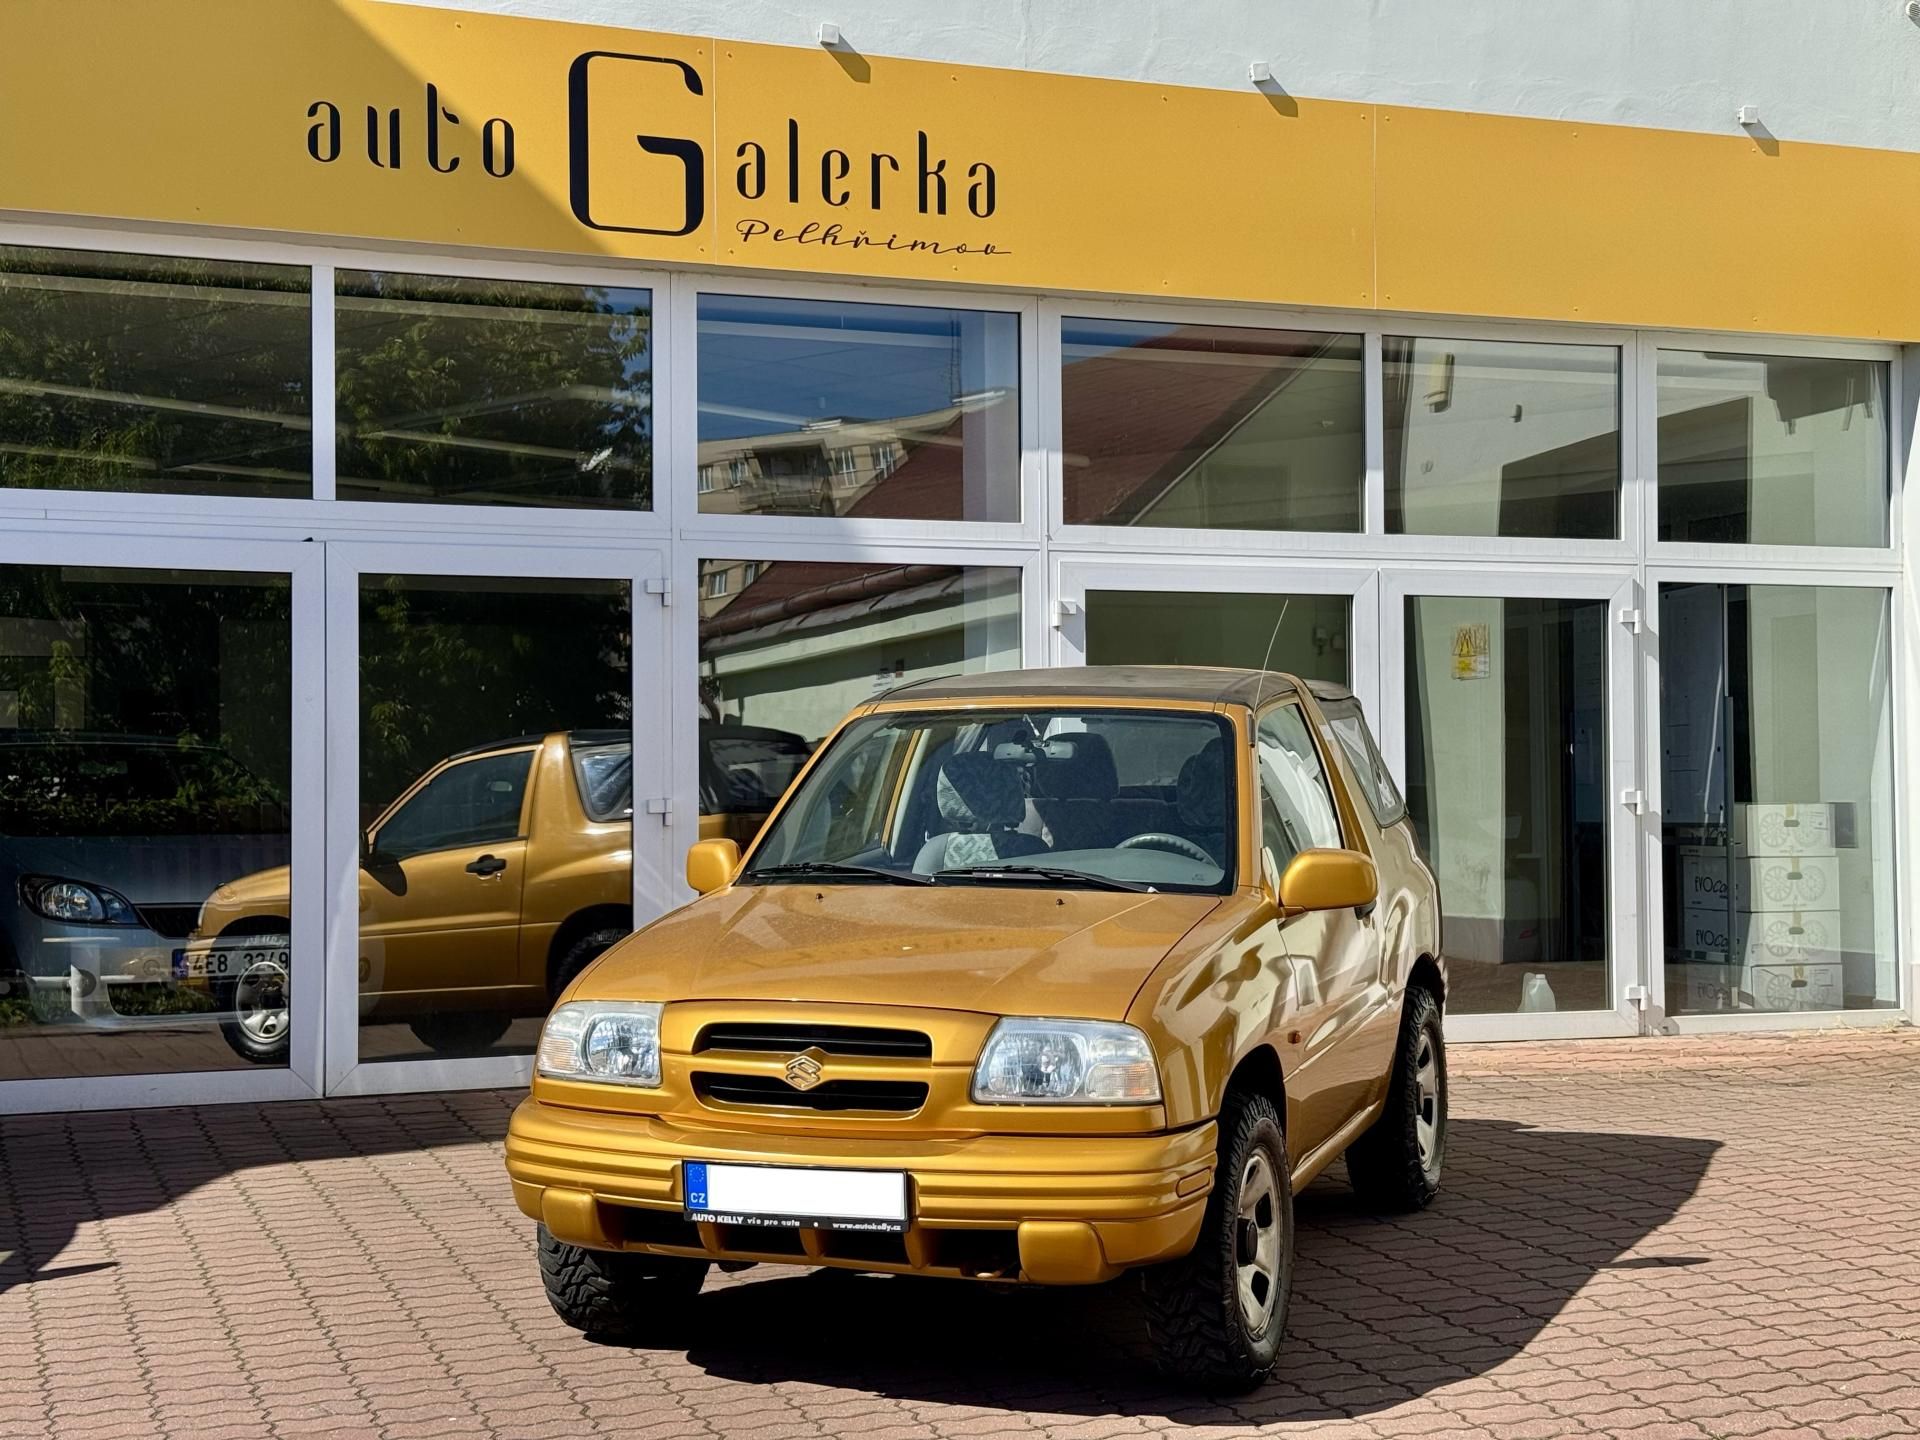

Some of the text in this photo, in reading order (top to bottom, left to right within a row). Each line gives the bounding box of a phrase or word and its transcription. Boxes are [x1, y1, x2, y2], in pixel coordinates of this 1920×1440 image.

[307, 82, 515, 178] auto
[736, 219, 1012, 256] Pelhřimov
[690, 1192, 706, 1203] CZ
[692, 1213, 715, 1222] AUTO
[717, 1215, 744, 1224] KELLY
[832, 1222, 902, 1232] www.autokelly.cz
